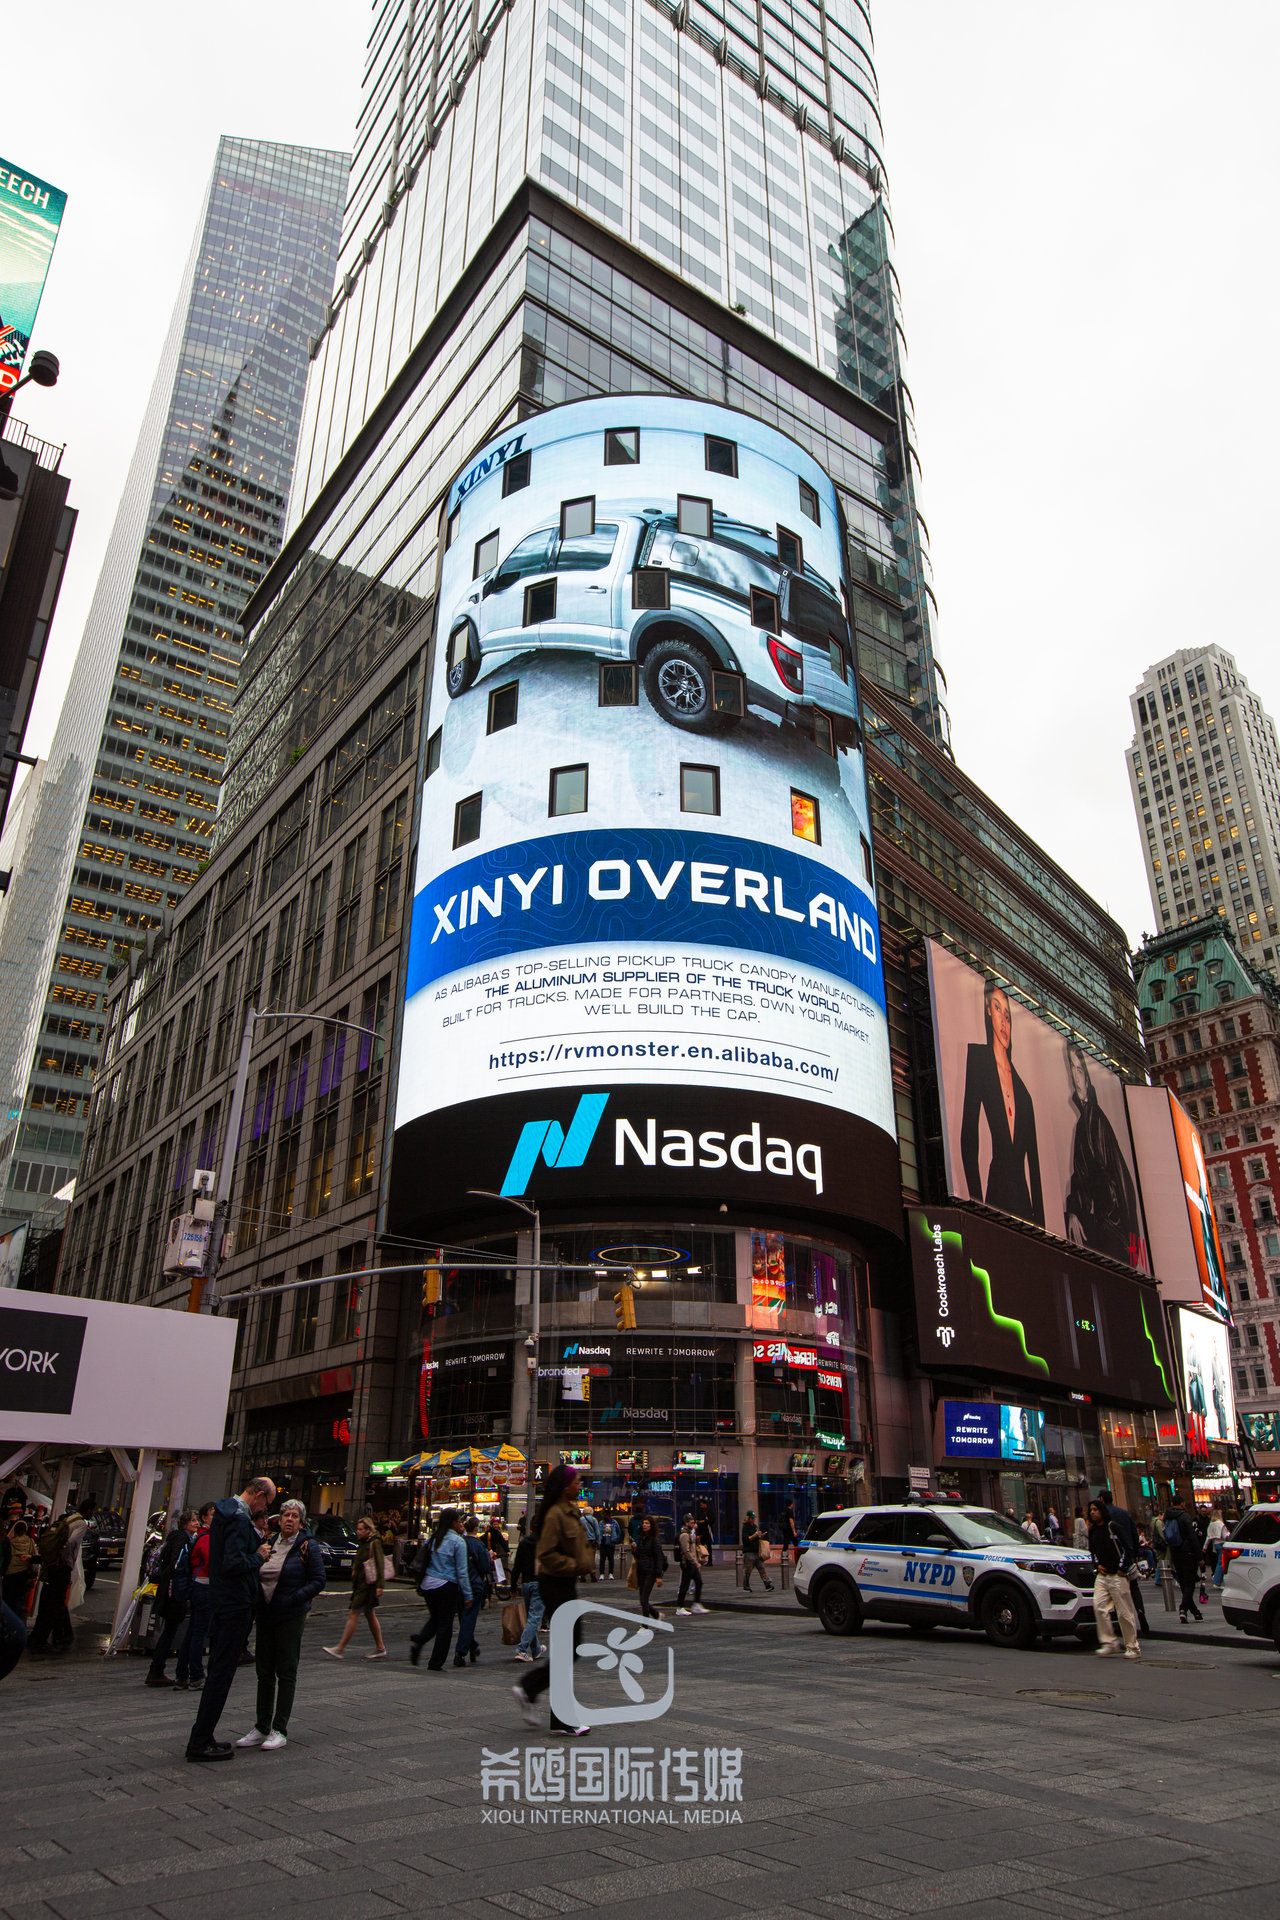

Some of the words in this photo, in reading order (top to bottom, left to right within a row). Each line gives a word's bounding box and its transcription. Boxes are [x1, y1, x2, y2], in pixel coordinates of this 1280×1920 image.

[454, 432, 527, 507] XINYI
[431, 864, 564, 944] XINYI
[588, 859, 877, 966] OVERLAND
[434, 989, 448, 1002] AS
[450, 969, 510, 995] ALIBABA'S
[516, 955, 611, 976] TOP-SELLING
[617, 955, 676, 967] PICKUP
[682, 957, 734, 972] TRUCK
[739, 963, 797, 984] CANOPY
[801, 976, 876, 1019] MANUFACTURER
[485, 984, 510, 999] THE
[514, 973, 597, 992] ALUMINUM
[602, 971, 680, 984] SUPPLIER
[686, 973, 707, 985] OF
[712, 975, 742, 989] THE
[747, 979, 794, 1000] TRUCK
[797, 990, 842, 1015] WORLD.
[442, 1008, 473, 1028] BUILT
[476, 1001, 502, 1018] FOR
[507, 991, 569, 1009] TRUCKS.
[574, 987, 623, 1001] MADE
[628, 987, 662, 999] FOR
[668, 988, 756, 1007] PARTNERS.
[760, 997, 795, 1015] OWN
[799, 1006, 831, 1026] YOUR
[834, 1018, 871, 1046] MARKET.
[584, 1004, 632, 1016] WE'LL
[637, 1004, 684, 1016] BUILD
[690, 1005, 721, 1018] THE
[727, 1009, 761, 1024] CAP.
[489, 1041, 840, 1082] https://rvmonster.en.alibaba.com/
[615, 1118, 824, 1195] Nasdaq
[932, 1223, 944, 1252] Labs
[933, 1253, 950, 1318] Cockroach
[445, 1356, 468, 1367] REWRITE
[469, 1352, 506, 1364] TOMORROW
[578, 1345, 611, 1357] Nasdaq
[626, 1347, 664, 1356] REWRITE
[667, 1347, 717, 1357] TOMORROW
[622, 1407, 669, 1421] Nasdaq
[951, 1436, 994, 1445] TOMORROW
[956, 1426, 988, 1434] REWRITE
[1159, 1423, 1178, 1438] H&M
[983, 1554, 1006, 1562] POLICE
[903, 1561, 956, 1587] NYPD
